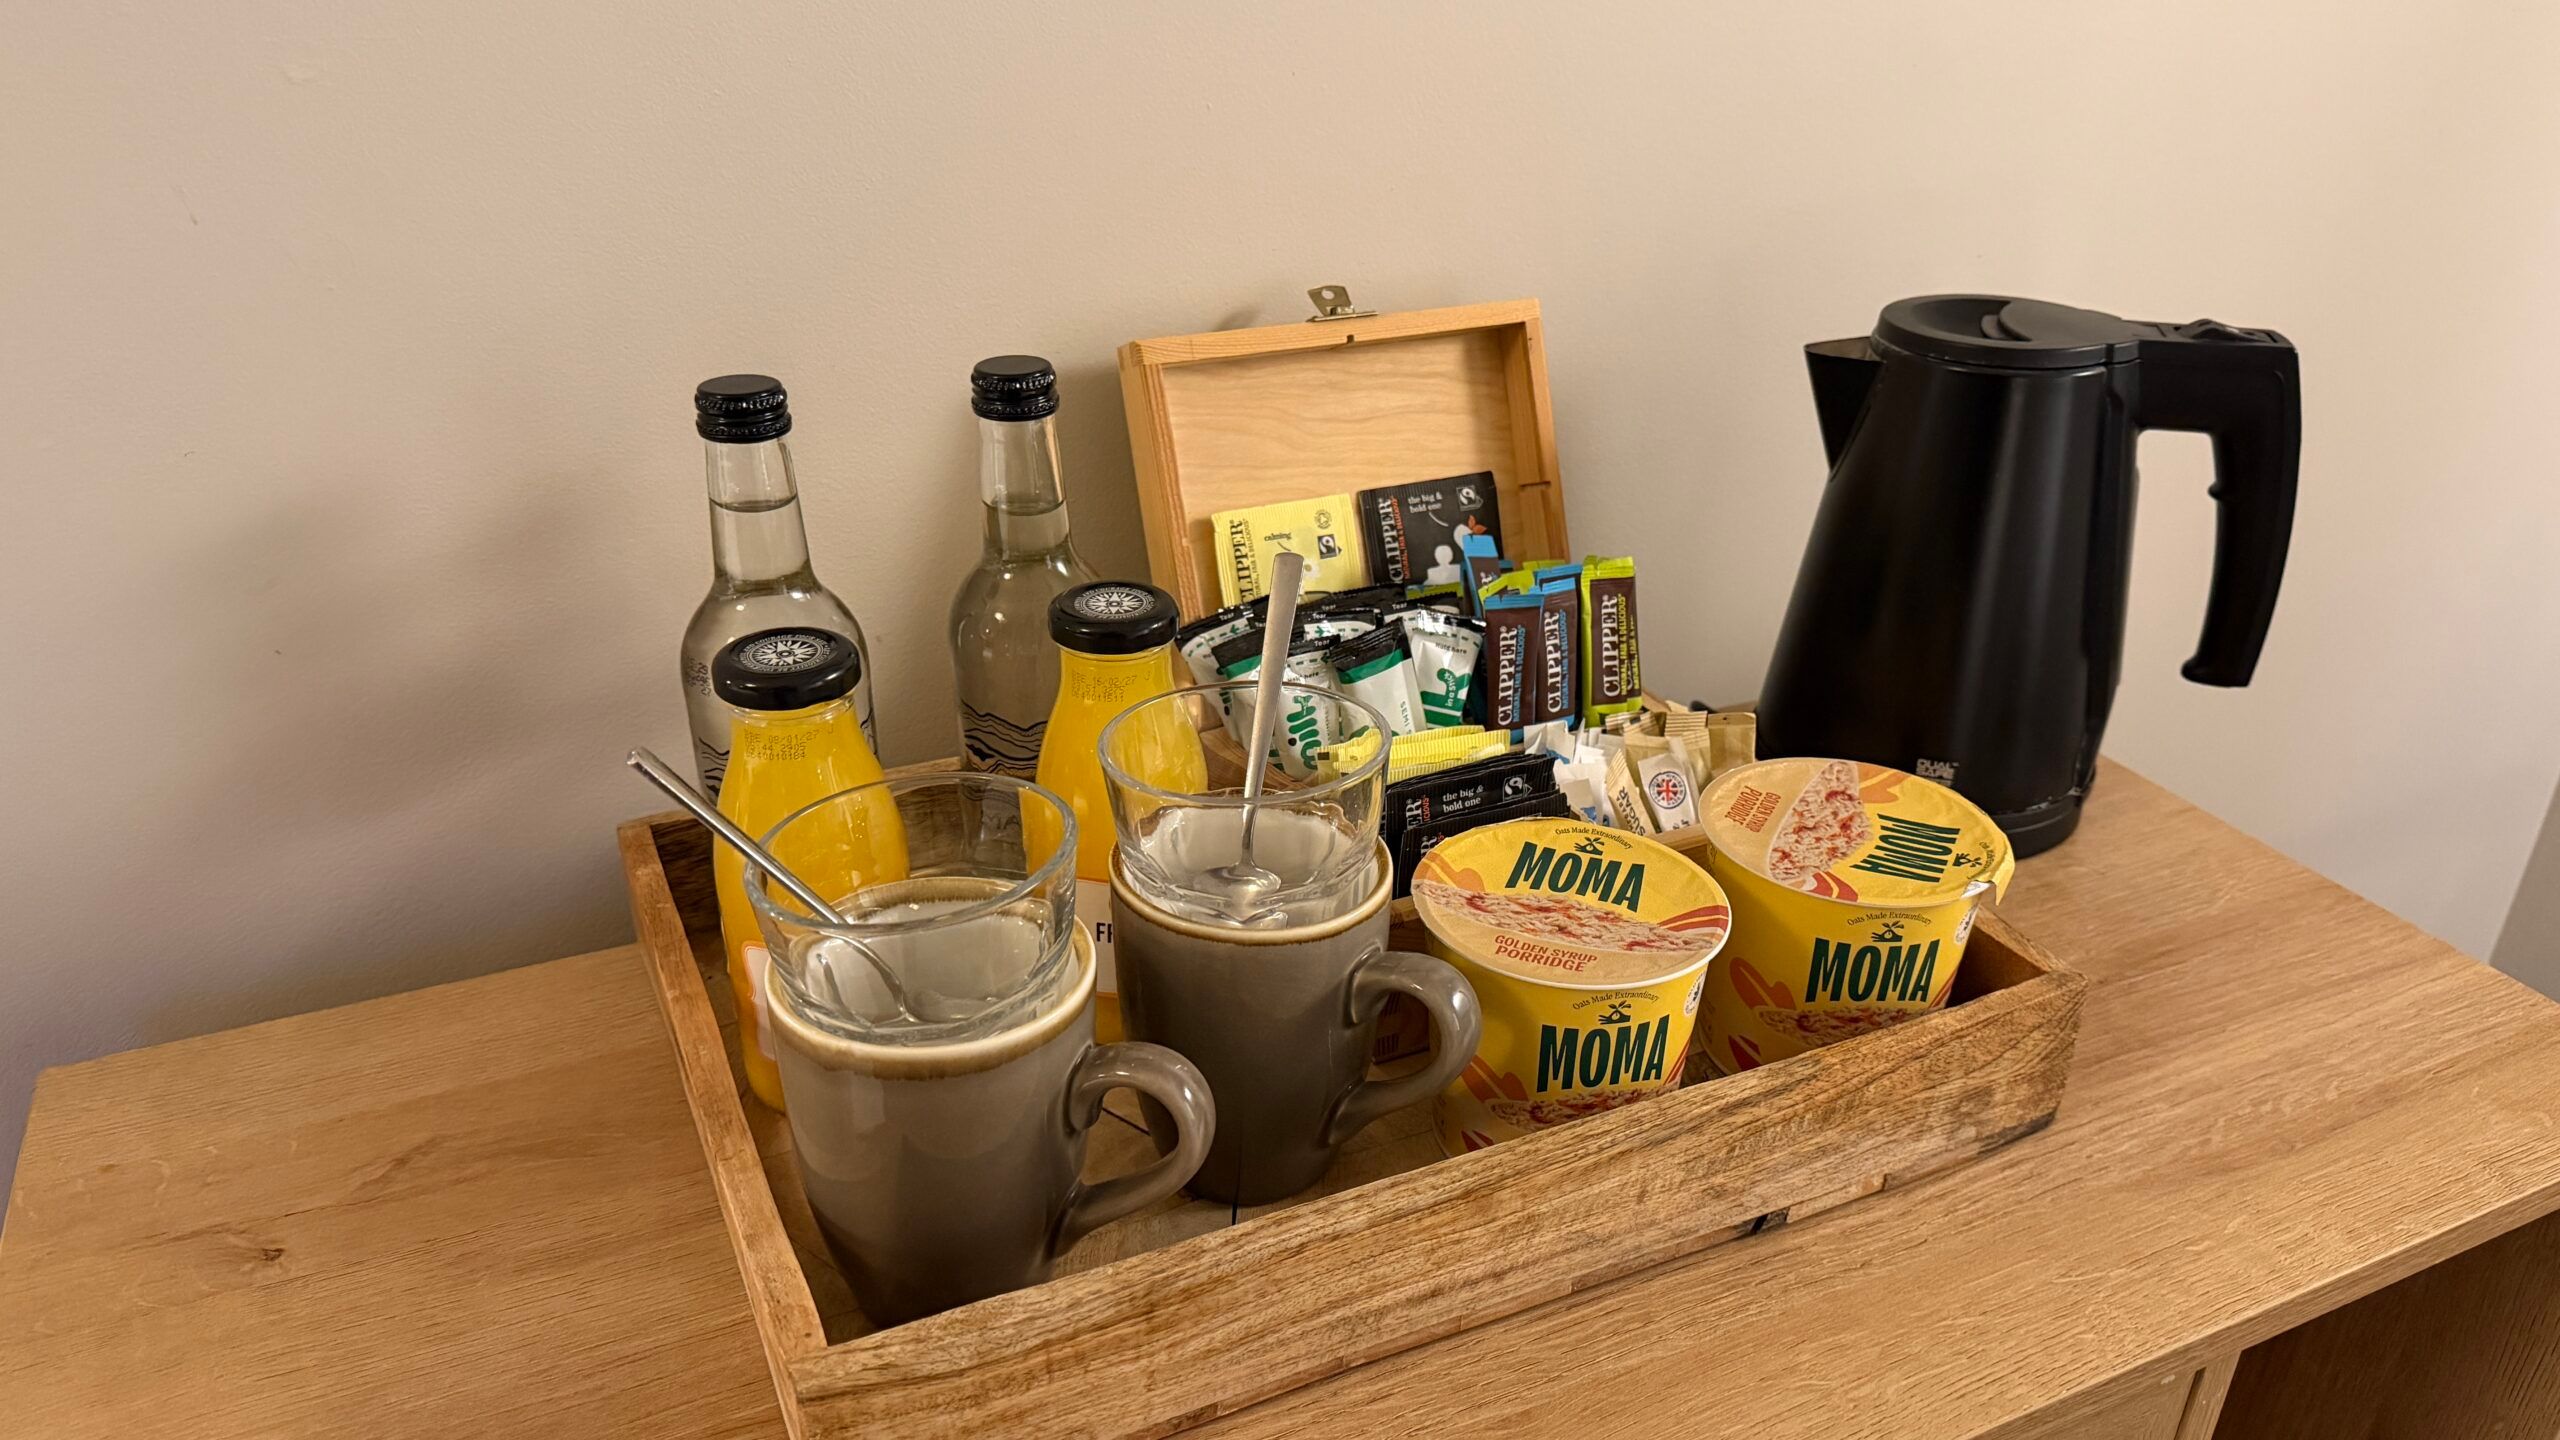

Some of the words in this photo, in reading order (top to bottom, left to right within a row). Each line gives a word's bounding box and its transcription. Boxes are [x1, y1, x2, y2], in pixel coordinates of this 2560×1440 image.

[1408, 496, 1421, 504] the
[1421, 494, 1435, 503] big
[1435, 491, 1443, 500] &
[1409, 504, 1427, 513] bold
[1427, 503, 1442, 511] one
[1219, 612, 1235, 621] Tear
[1392, 602, 1408, 610] Tear
[1314, 638, 1330, 647] Tear
[1400, 701, 1411, 727] SEMI
[1442, 790, 1458, 802] the
[1460, 786, 1474, 800] big
[1476, 785, 1484, 793] &
[1755, 791, 1781, 817] GOLDEN
[1443, 802, 1463, 813] bold
[1465, 797, 1481, 808] one
[1724, 785, 1763, 825] PORRIDGE
[1555, 827, 1571, 835] Oats
[1590, 828, 1633, 849] Extraordinary
[1849, 813, 1961, 883] MOMA
[1505, 841, 1645, 913] MOMA
[1847, 916, 1865, 926] Oats
[1865, 912, 1887, 921] Made
[1494, 935, 1549, 956] GOLDEN
[1549, 949, 1598, 964] SYRUP
[1494, 946, 1587, 973] PORRIDGE
[1805, 937, 1940, 1003] MOMA
[1572, 999, 1591, 1010] Oats
[1591, 993, 1613, 1004] Made
[1536, 1014, 1670, 1093] MOMA
